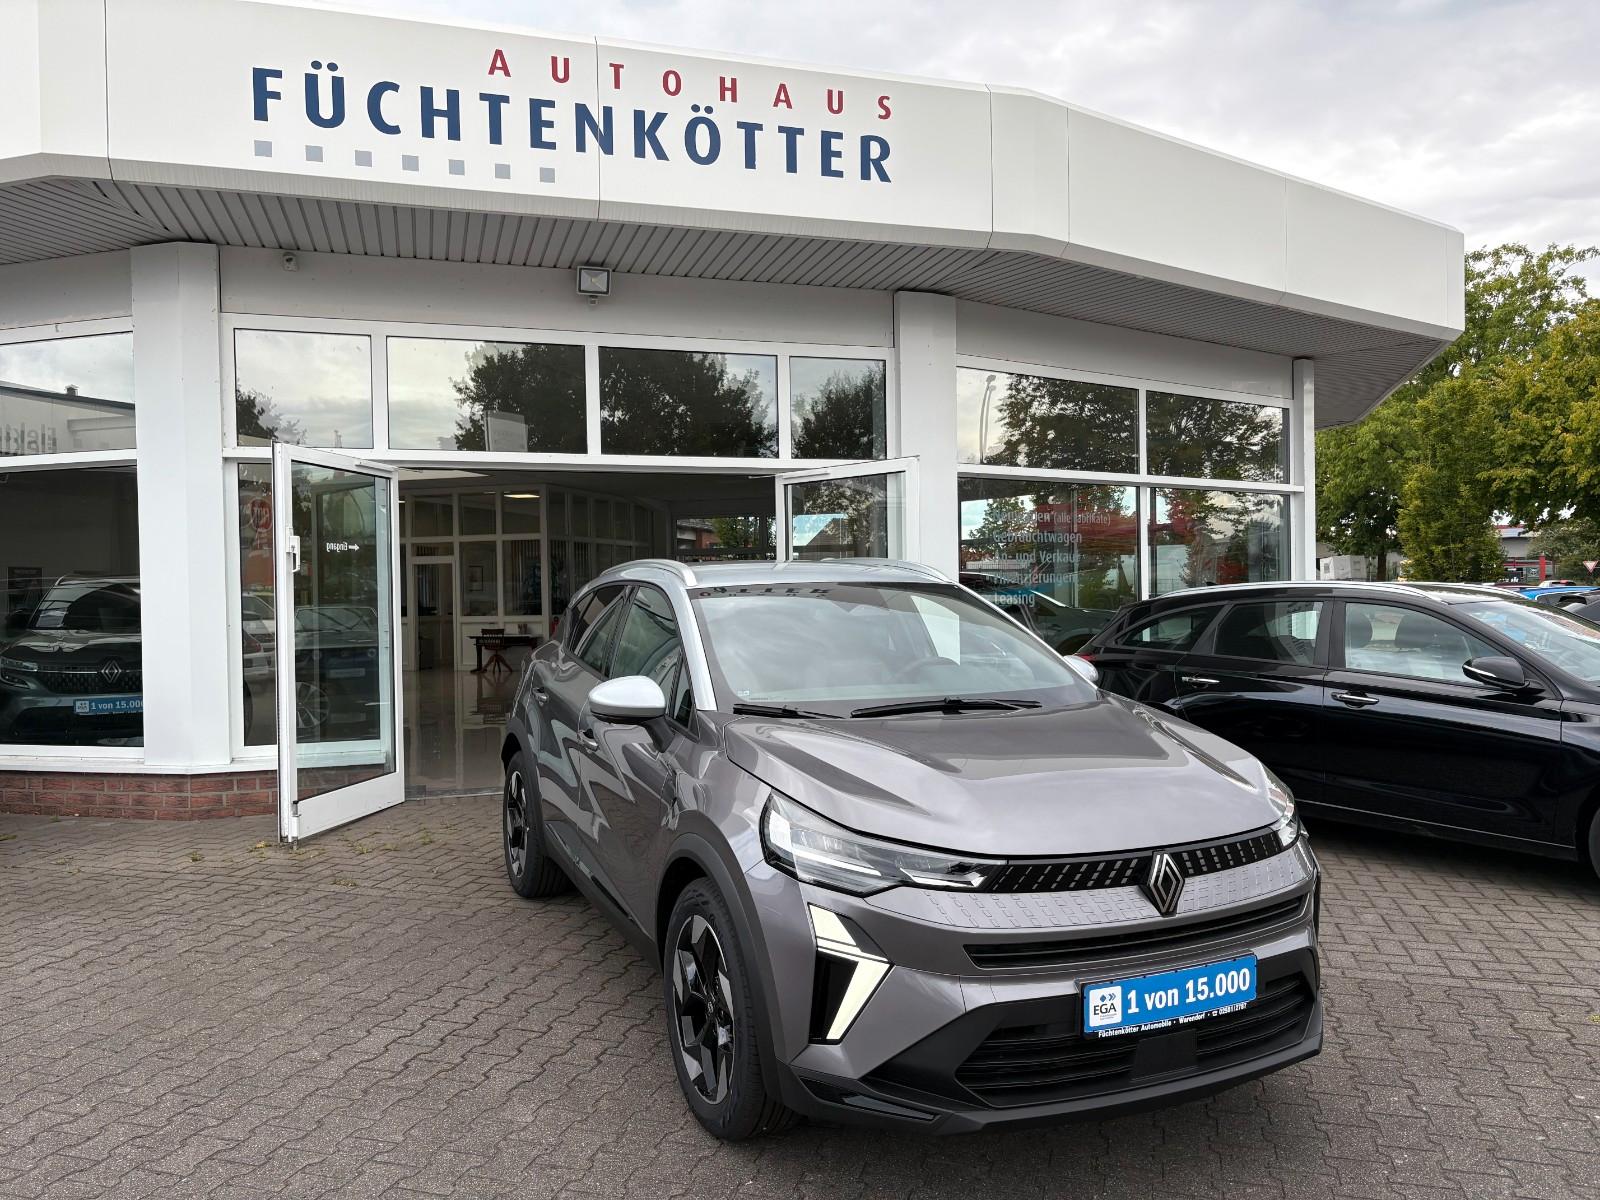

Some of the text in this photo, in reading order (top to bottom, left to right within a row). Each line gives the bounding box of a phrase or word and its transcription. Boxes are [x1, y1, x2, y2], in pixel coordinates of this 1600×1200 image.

[488, 49, 892, 120] AUTOHAUS
[252, 60, 892, 183] FÜCHTENKÖTTER
[993, 510, 1110, 527] Neugen (alle abrikate)
[993, 529, 1082, 546] Gebrauchtwagen
[1015, 548, 1036, 562] und
[993, 571, 1080, 586] innzierungen
[994, 590, 1035, 608] Leasing
[91, 702, 97, 710] 1
[1127, 968, 1250, 1014] 1 von 15.000
[1093, 1002, 1117, 1016] EGA
[1098, 1025, 1139, 1038] Füchtenkötter
[1140, 1020, 1172, 1031] Automobile
[1179, 1013, 1206, 1024] Warendorf
